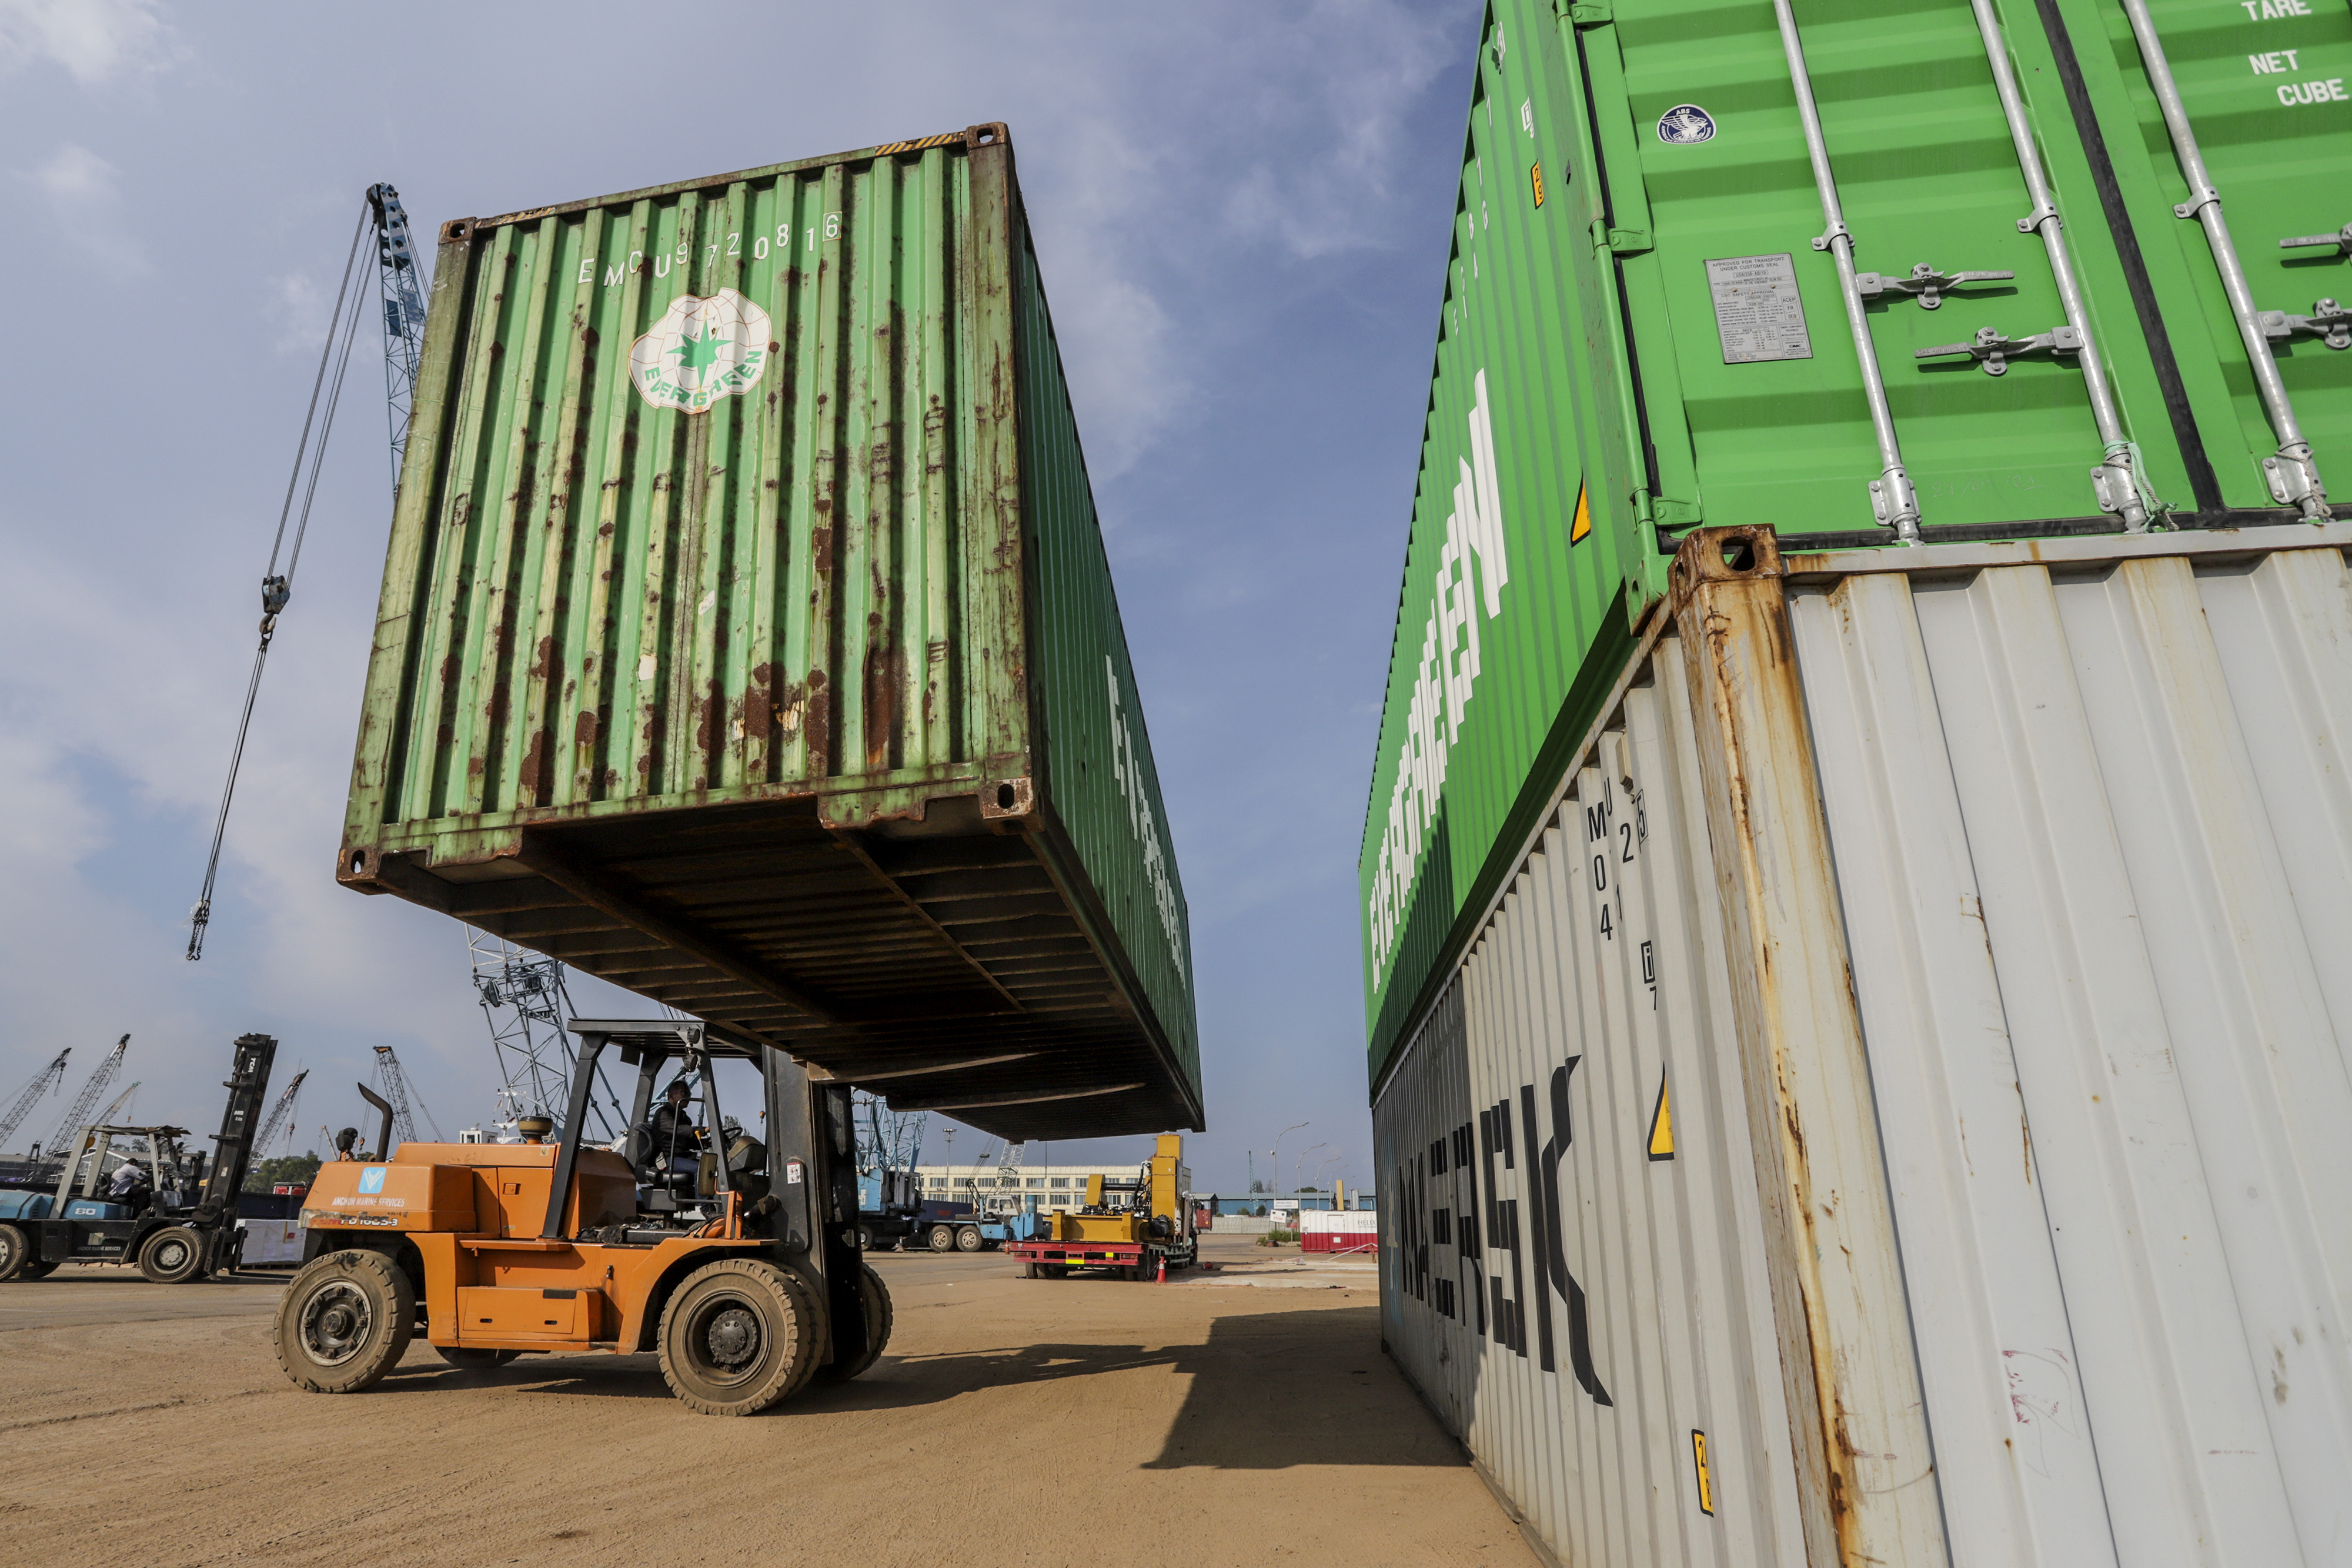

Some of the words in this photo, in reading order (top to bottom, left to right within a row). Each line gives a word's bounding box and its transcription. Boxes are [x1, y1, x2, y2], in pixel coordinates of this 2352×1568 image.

[2240, 0, 2313, 21] TARE
[2248, 49, 2298, 75] NET
[2276, 78, 2350, 106] CUBE
[644, 350, 763, 406] EVERGREEN
[332, 1197, 355, 1206] ANCHOR
[356, 1198, 377, 1206] MARINE
[379, 1198, 405, 1207] SERVICES
